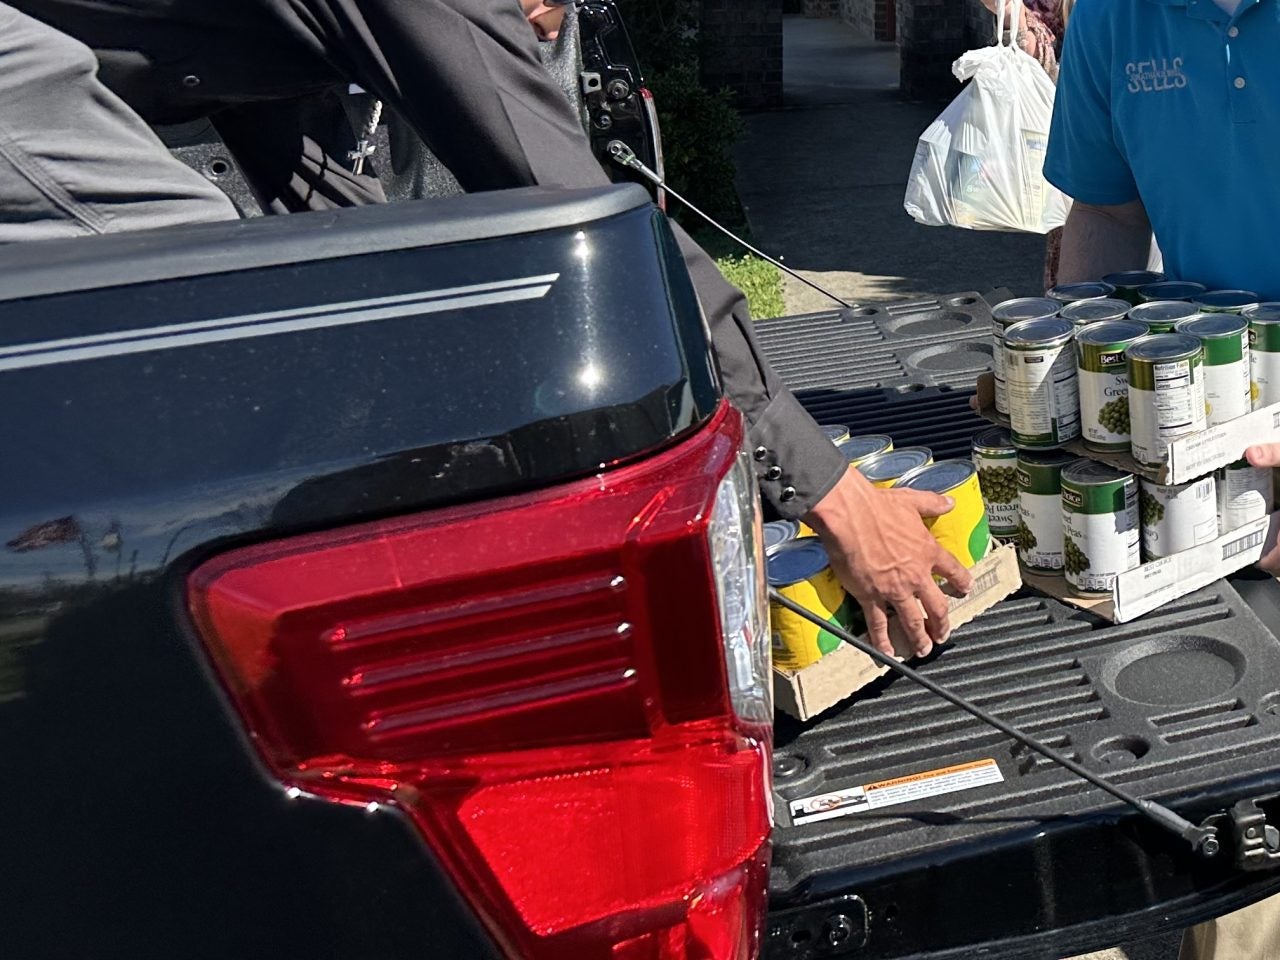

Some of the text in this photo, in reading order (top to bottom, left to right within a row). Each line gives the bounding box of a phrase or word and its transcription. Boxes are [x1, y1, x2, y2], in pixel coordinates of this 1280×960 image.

[1125, 56, 1188, 93] SELLS
[1100, 353, 1119, 365] Best
[1104, 386, 1128, 397] Gree
